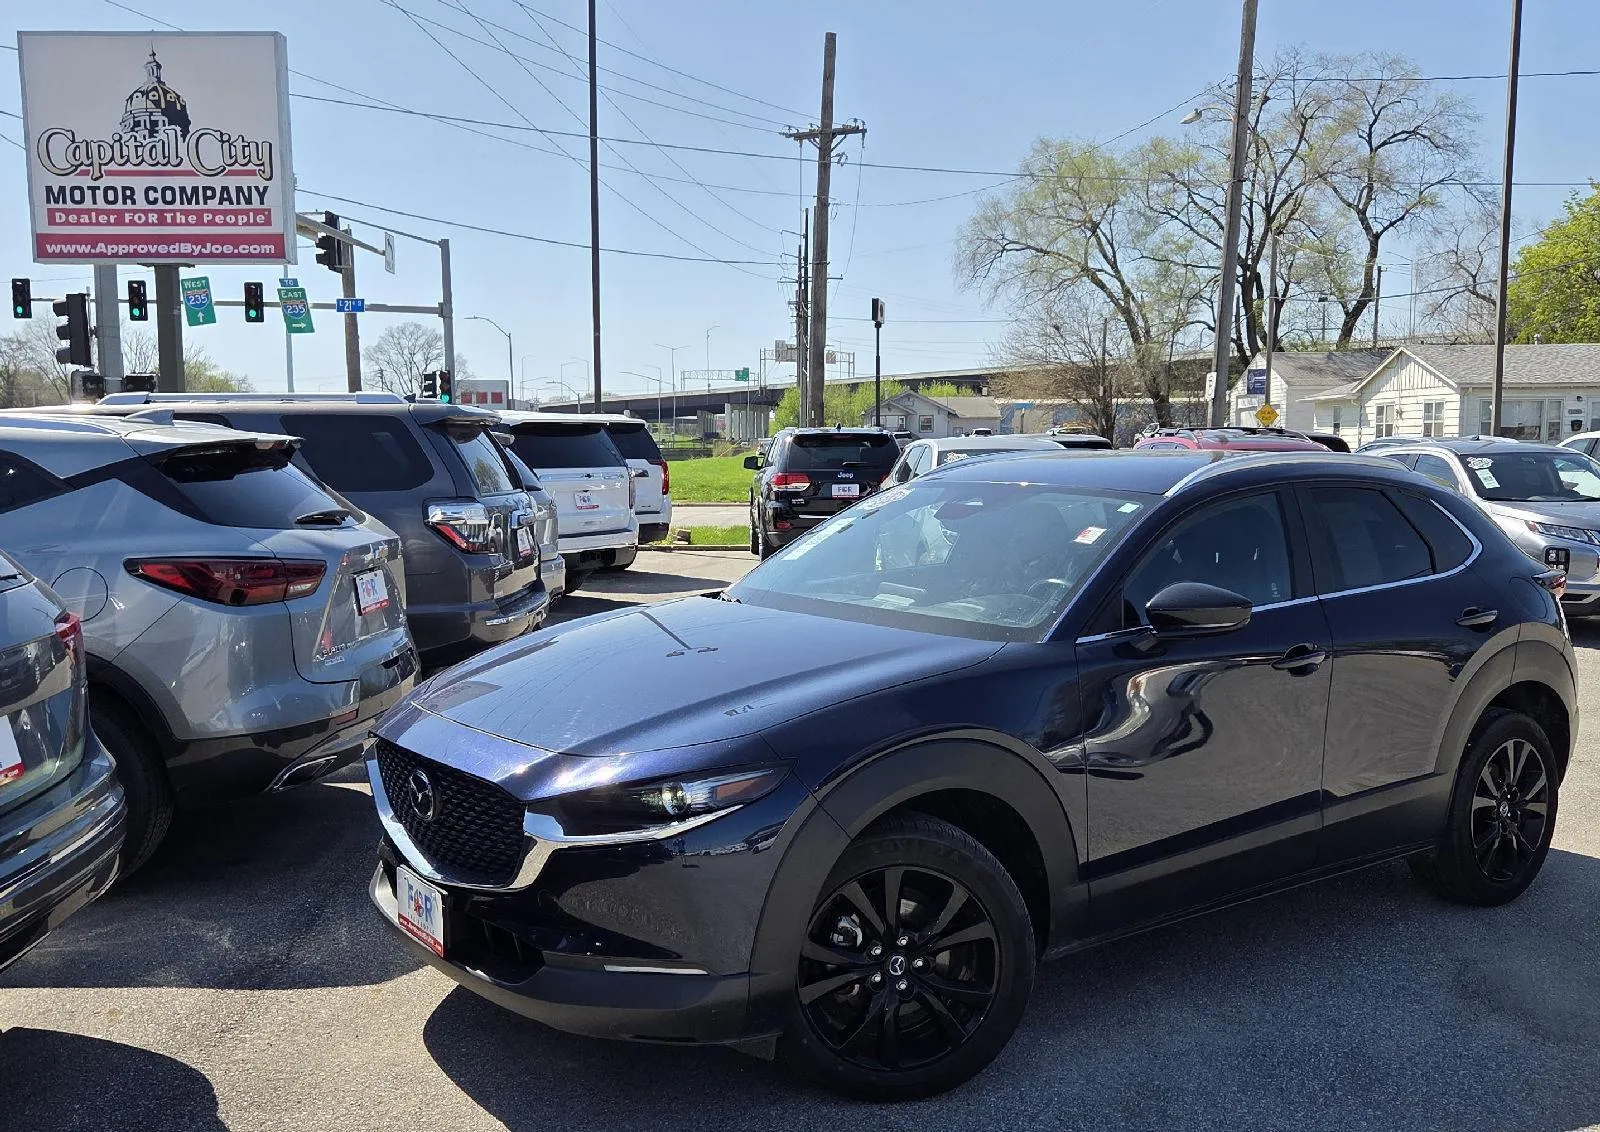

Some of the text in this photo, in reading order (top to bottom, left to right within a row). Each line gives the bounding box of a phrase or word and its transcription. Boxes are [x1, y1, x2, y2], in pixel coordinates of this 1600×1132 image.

[37, 128, 273, 181] Capital City
[45, 185, 269, 206] MOTOR COMPANY
[55, 212, 265, 226] Dealer FOR The People
[46, 241, 275, 256] www.ApprovedByJoe.com
[183, 279, 206, 289] WEST
[188, 294, 208, 305] 235
[281, 289, 303, 298] EAST
[286, 303, 306, 314] 235
[837, 471, 854, 479] Jeep
[407, 881, 434, 925] FOR
